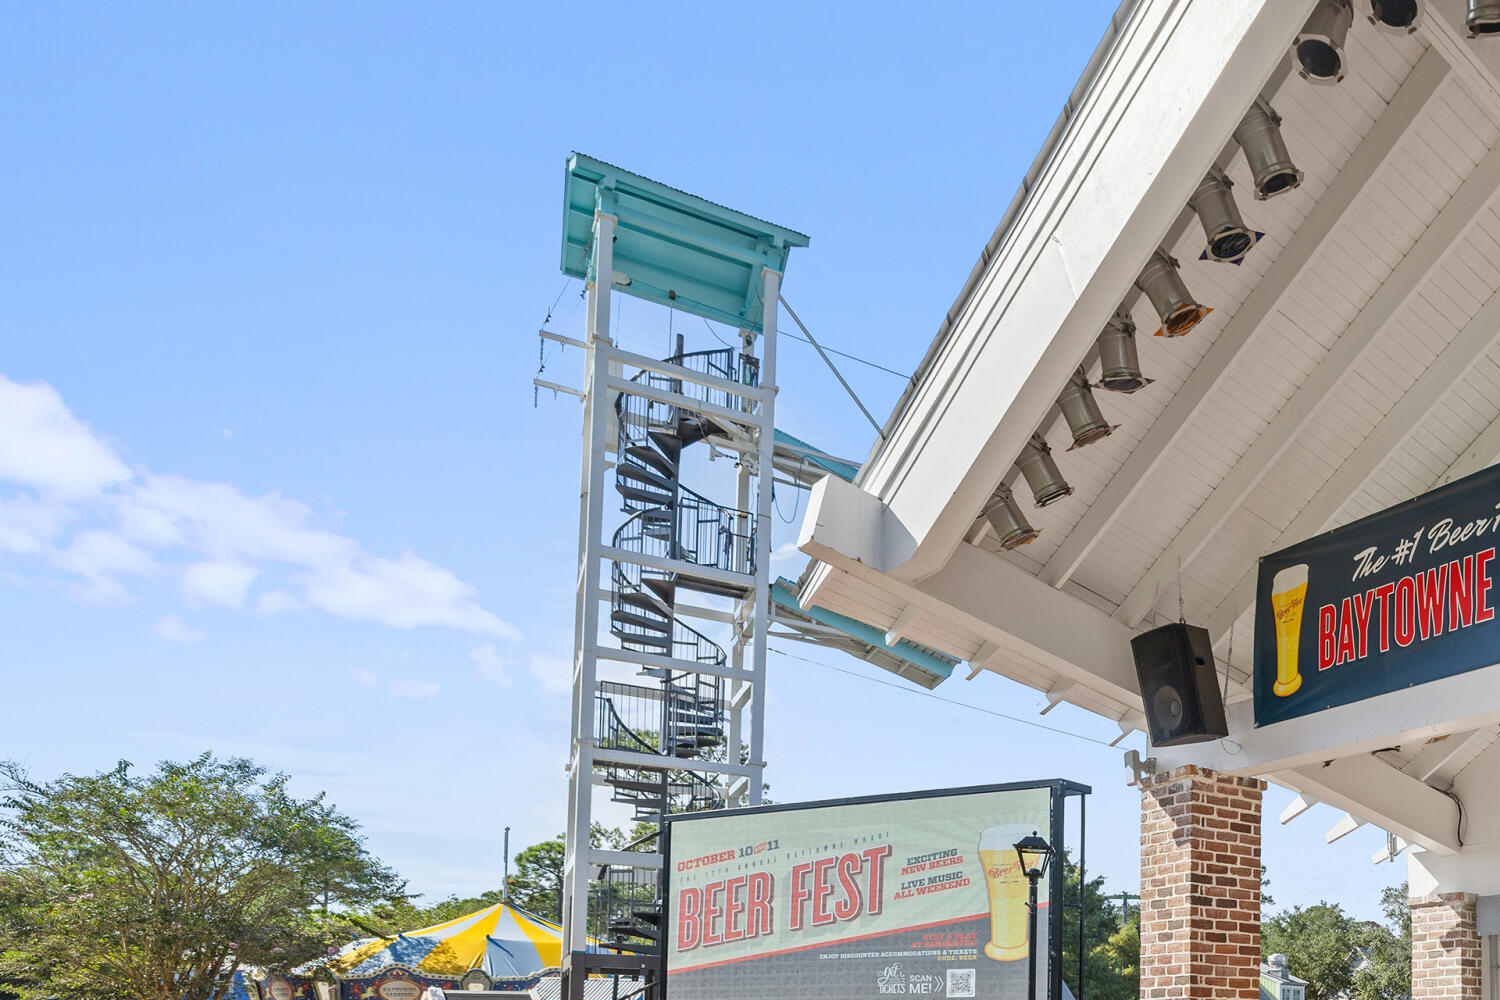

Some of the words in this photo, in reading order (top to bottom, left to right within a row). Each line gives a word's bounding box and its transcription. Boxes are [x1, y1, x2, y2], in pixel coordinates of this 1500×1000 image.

[1352, 546, 1391, 582] The
[1391, 525, 1427, 566] #1
[1428, 517, 1494, 555] Beer
[1318, 547, 1496, 672] BAYTOWNE
[677, 849, 736, 873] OCTOBER
[739, 845, 754, 858] 10
[767, 839, 780, 852] 11
[901, 864, 927, 876] NEW
[928, 855, 964, 871] BEERS
[906, 848, 958, 866] EXCITING
[893, 892, 915, 901] ALL
[915, 878, 971, 897] WEEKEND
[900, 878, 926, 891] LIVE
[927, 871, 964, 886] MUSIC
[676, 871, 775, 953] BEER
[788, 843, 893, 933] FEST
[880, 949, 942, 957] ACCOMMODATIONS
[877, 962, 903, 984] get
[909, 974, 932, 982] SCAN
[878, 982, 906, 994] TICKETS
[909, 983, 932, 994] ME!
